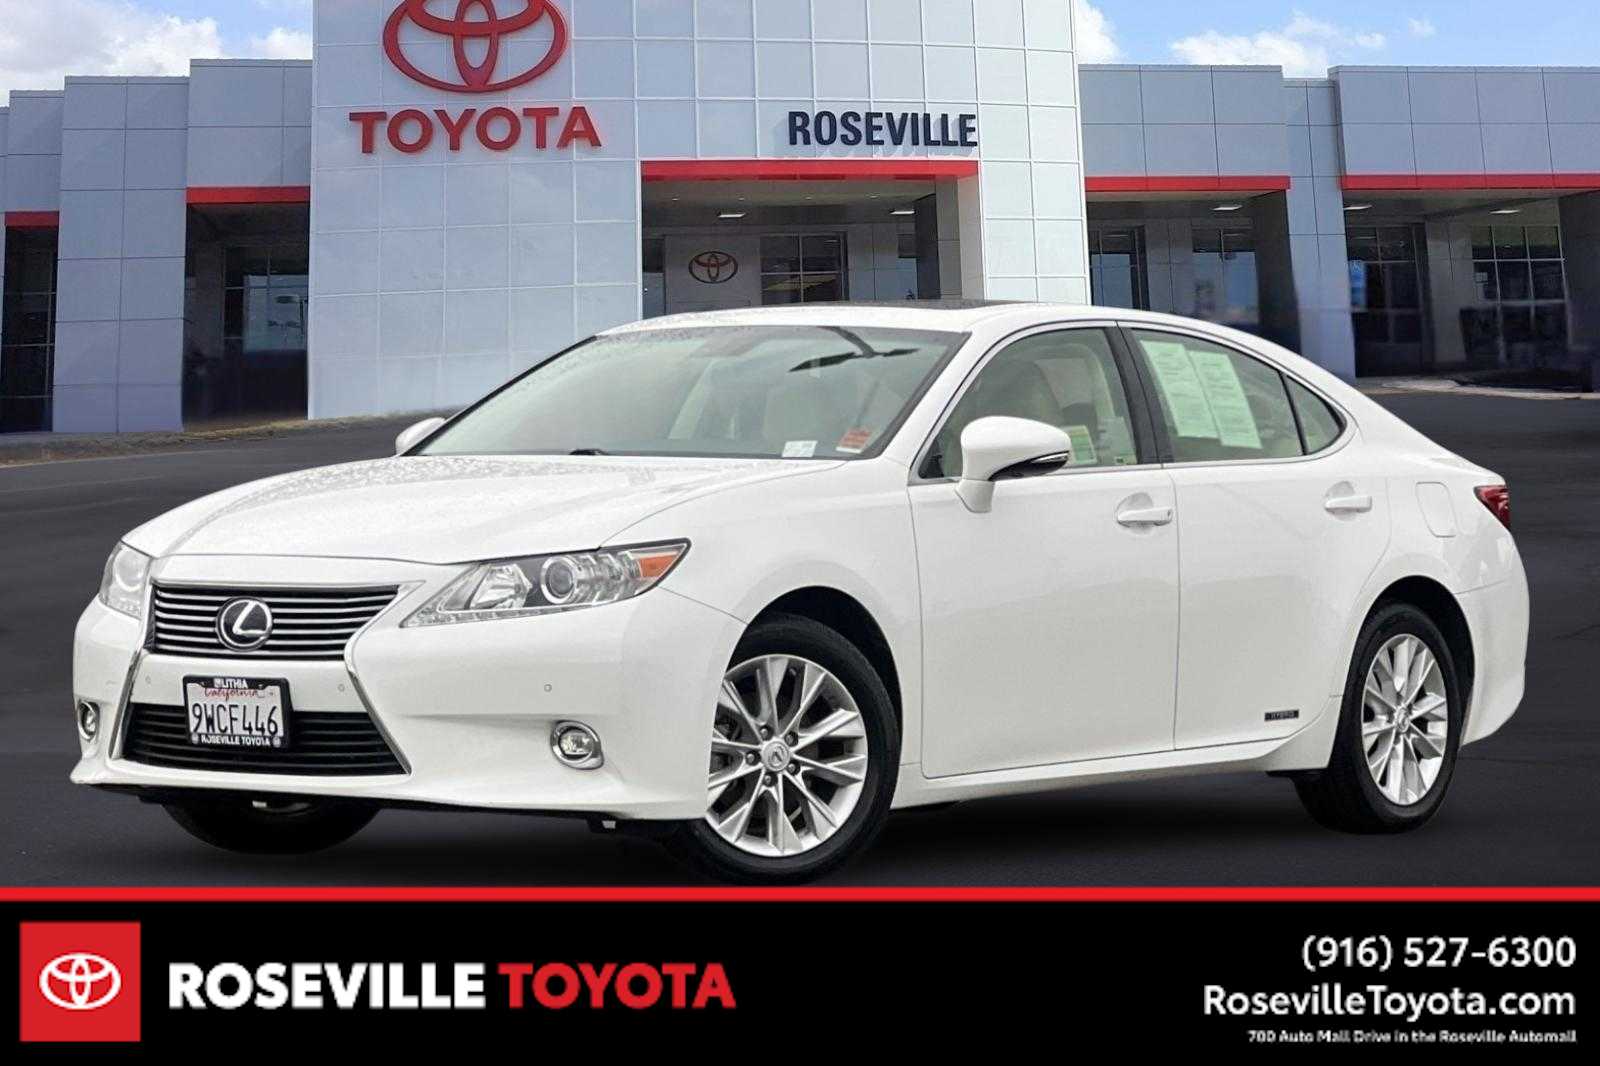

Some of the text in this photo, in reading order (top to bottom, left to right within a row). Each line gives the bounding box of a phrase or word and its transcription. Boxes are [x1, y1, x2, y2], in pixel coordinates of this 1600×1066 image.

[349, 105, 602, 154] TOYOTA
[788, 111, 978, 147] ROSEVILLE
[221, 678, 248, 689] LITHIA
[192, 703, 278, 735] 9WCF446
